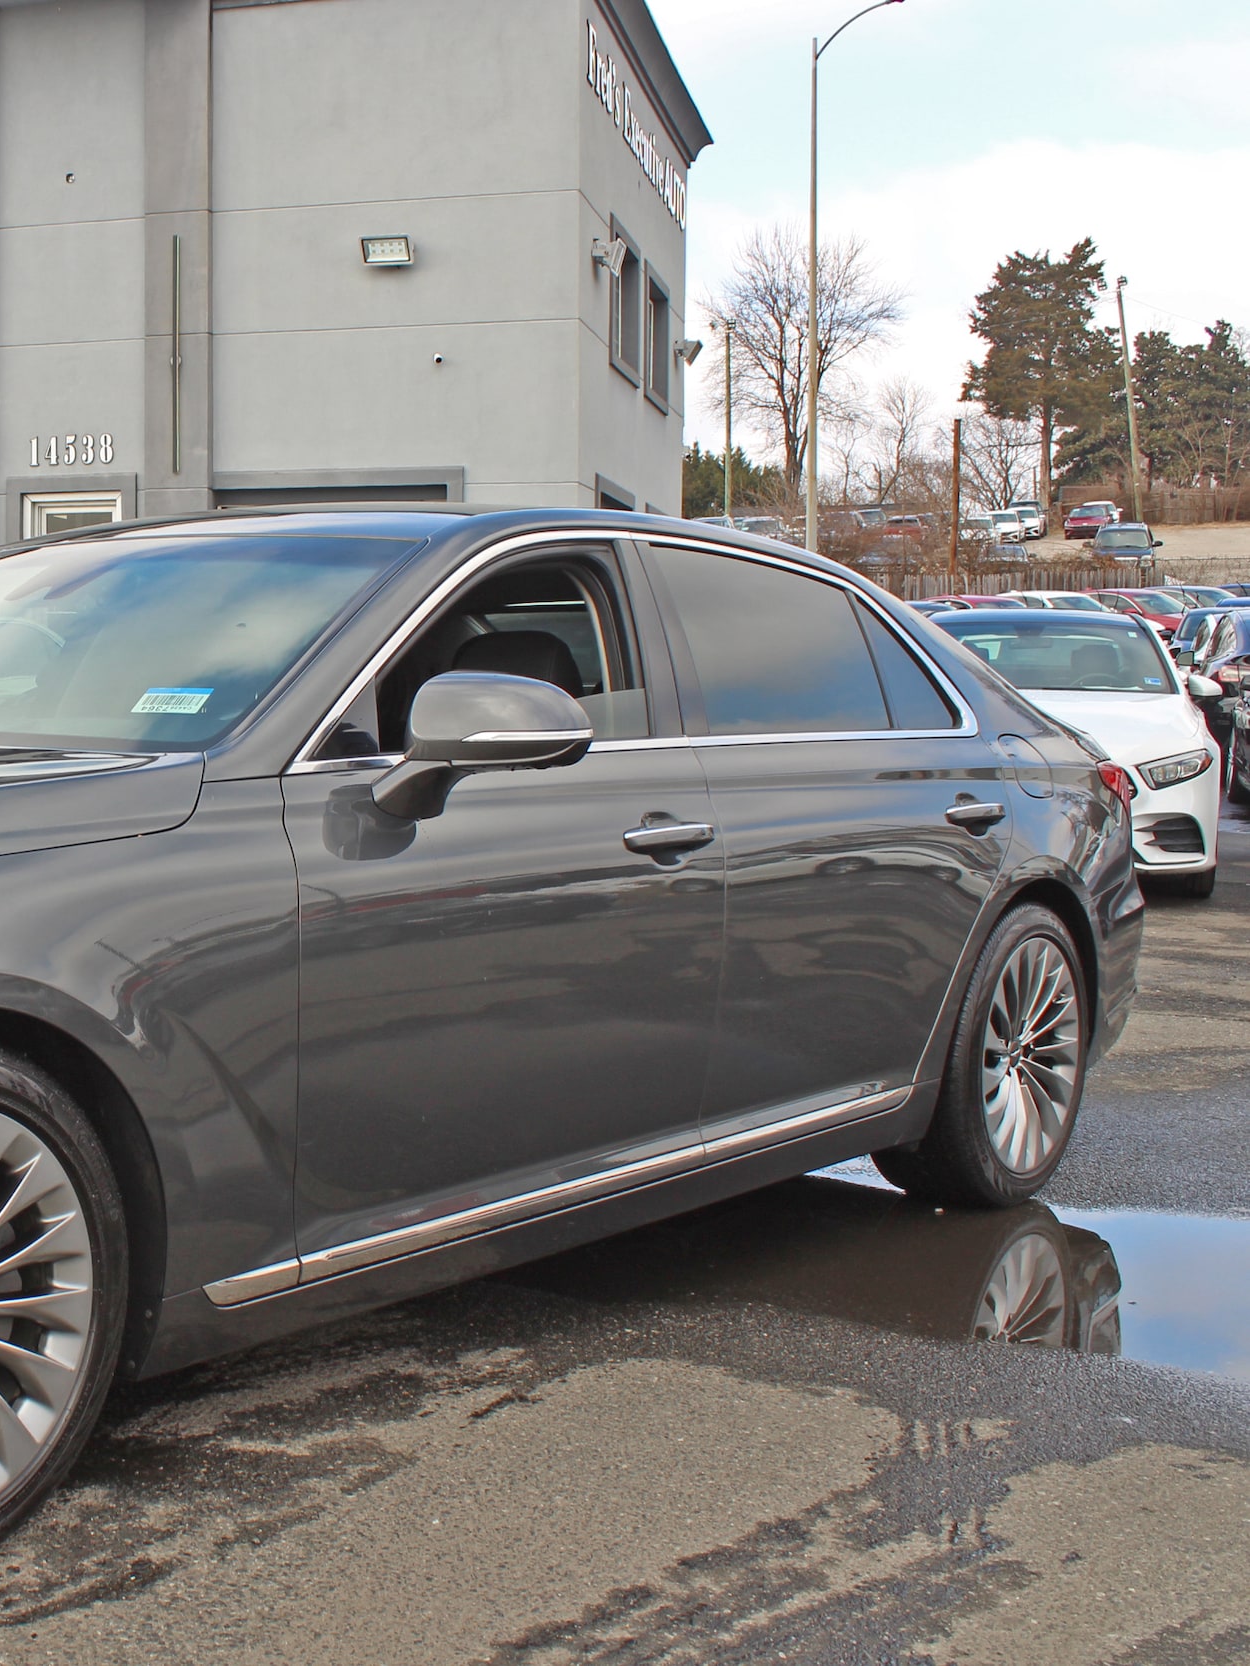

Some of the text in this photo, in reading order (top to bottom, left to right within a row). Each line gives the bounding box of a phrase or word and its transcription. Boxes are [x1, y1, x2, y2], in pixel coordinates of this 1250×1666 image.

[586, 19, 686, 231] Fred's Executive AUTO
[29, 433, 114, 467] 14538
